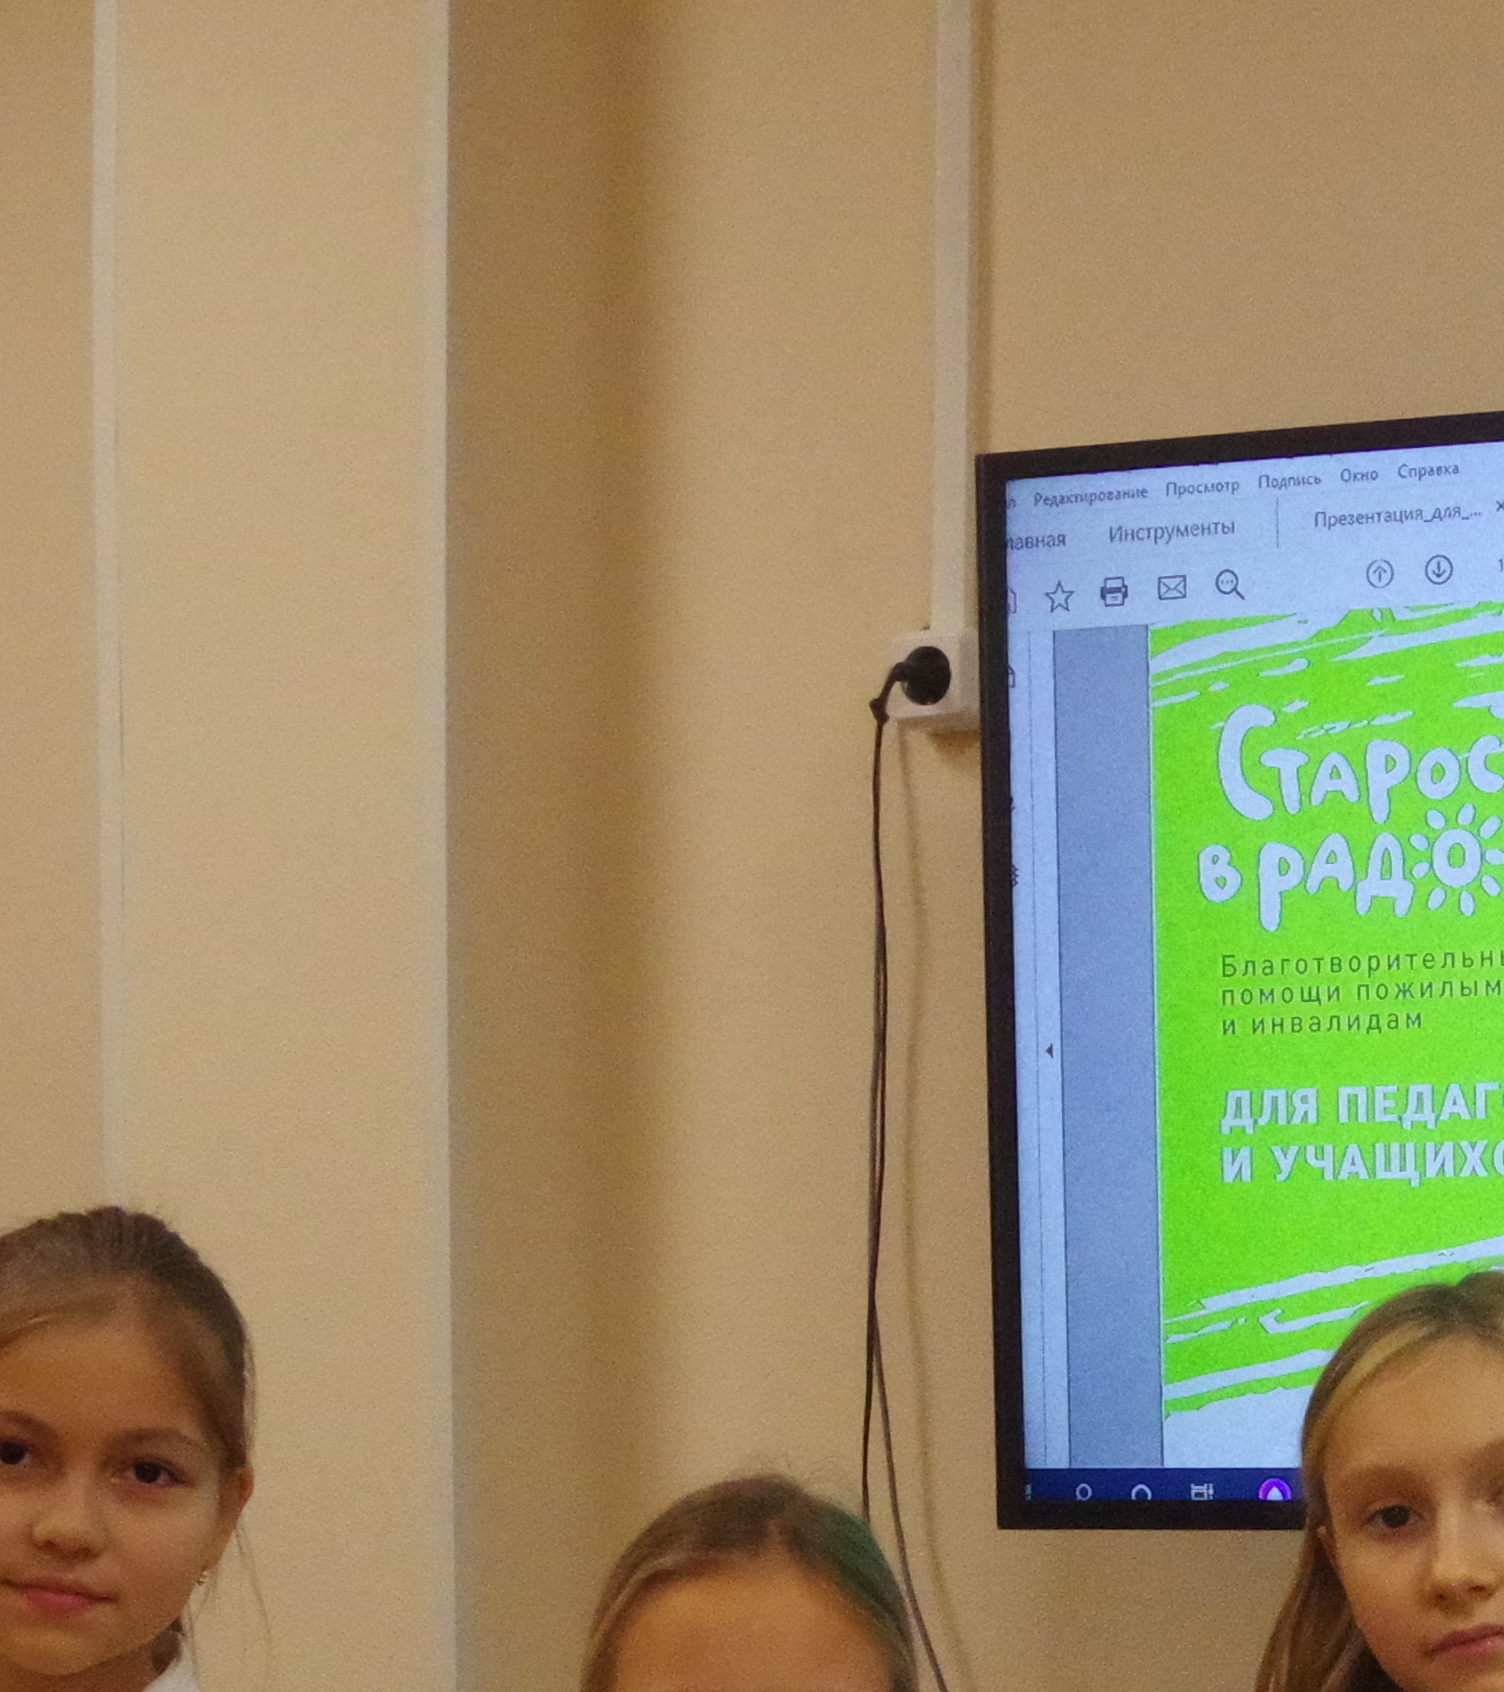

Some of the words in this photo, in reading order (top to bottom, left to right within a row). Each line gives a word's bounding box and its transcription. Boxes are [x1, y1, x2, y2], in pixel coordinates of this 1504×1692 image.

[1033, 487, 1149, 508] Редактирование
[1165, 478, 1241, 500] Просмотр
[1258, 473, 1322, 493] Подпись
[1340, 467, 1380, 484] Окно
[1397, 461, 1460, 482] Справка
[1006, 533, 1067, 550] лавная
[1108, 518, 1236, 546] Инструменты
[1498, 556, 1504, 572] 1
[1220, 983, 1342, 1008] помощи
[1356, 978, 1503, 1003] пожилым
[1221, 1017, 1236, 1037] и
[1252, 1011, 1423, 1037] инвалидам
[1220, 1087, 1318, 1135] ДЛЯ
[1221, 1147, 1252, 1183] И
